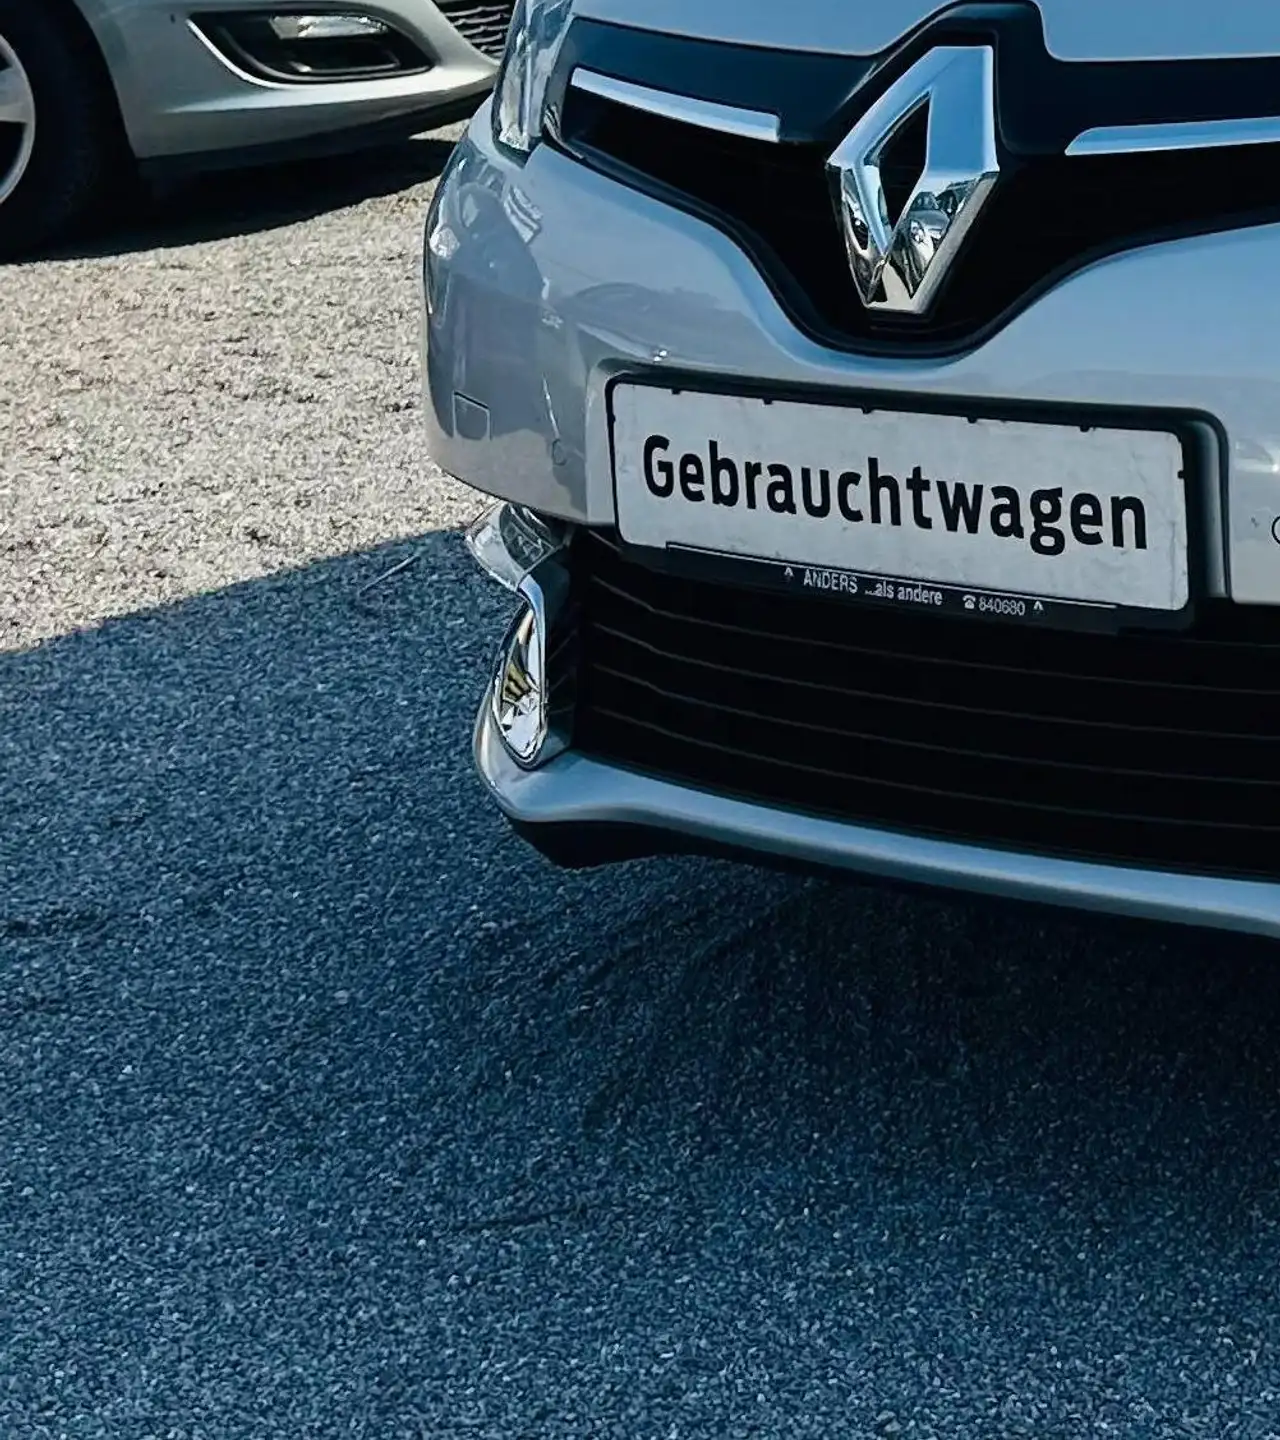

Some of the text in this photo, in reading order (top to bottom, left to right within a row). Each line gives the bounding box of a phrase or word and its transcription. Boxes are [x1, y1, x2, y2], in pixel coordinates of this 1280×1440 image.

[642, 433, 1148, 557] Gebrauchtwagen
[803, 568, 858, 594] ANDERS
[897, 584, 943, 606] andere
[978, 595, 1026, 617] 840680
